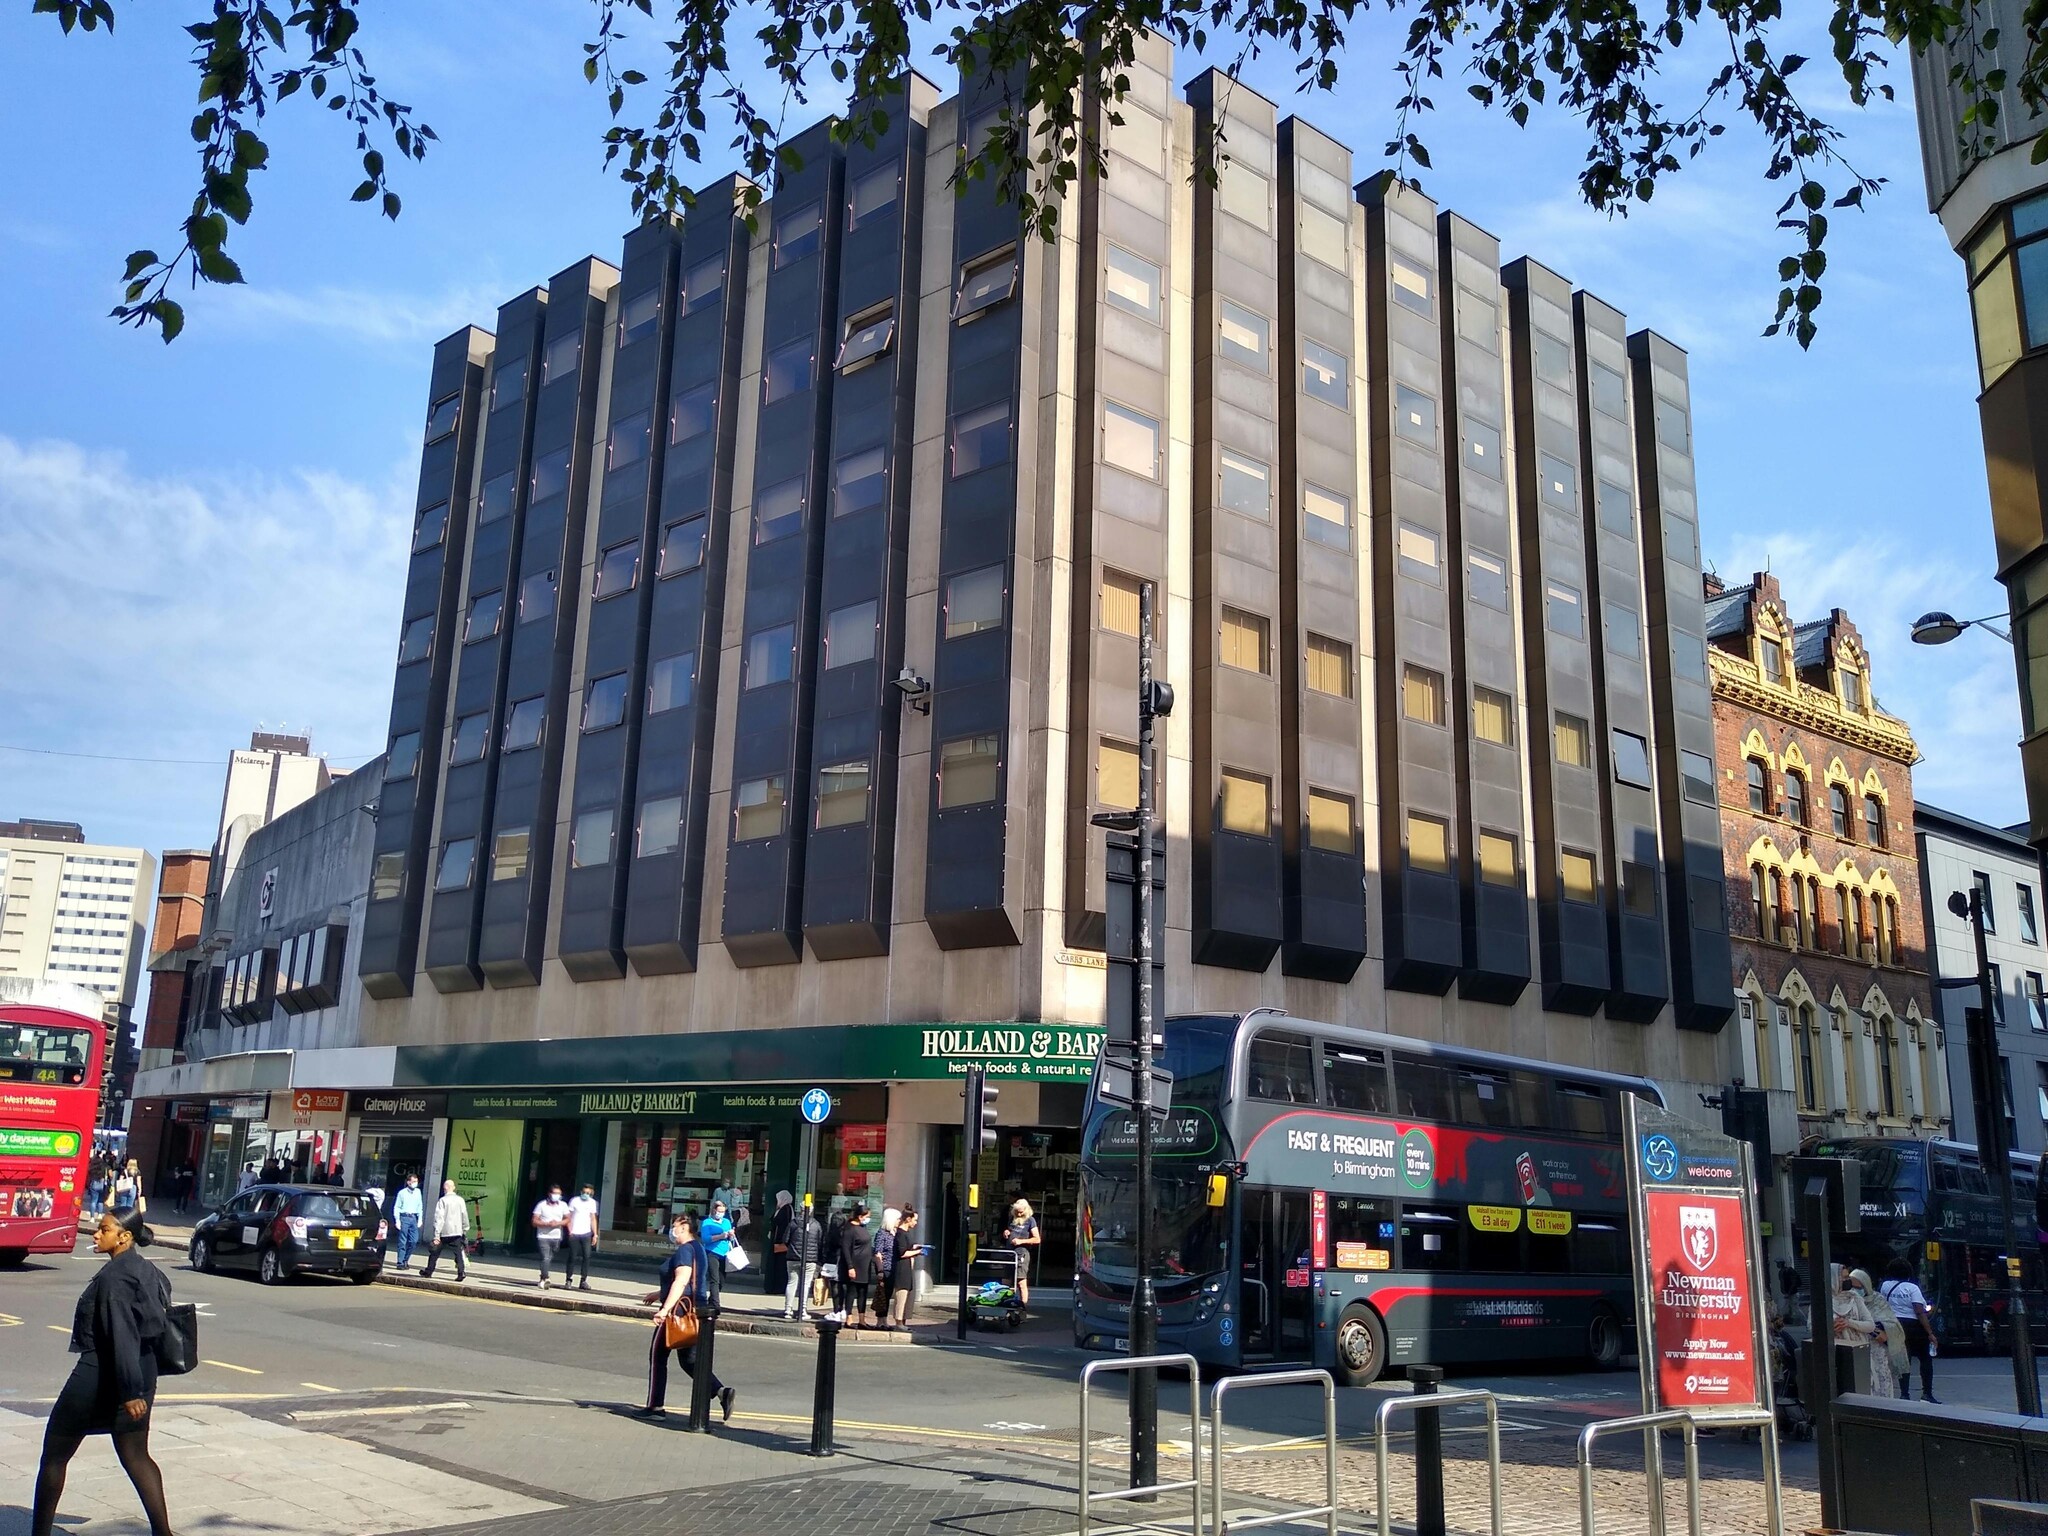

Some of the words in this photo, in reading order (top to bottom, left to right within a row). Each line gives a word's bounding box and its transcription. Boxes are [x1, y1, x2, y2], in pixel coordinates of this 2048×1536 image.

[1061, 954, 1083, 964] CARRS
[1086, 958, 1105, 967] LANE
[922, 1030, 1025, 1057] HOLLAND
[1029, 1031, 1052, 1058] &
[1057, 1032, 1107, 1055] BAR
[986, 1062, 1017, 1073] foods
[1021, 1063, 1031, 1074] &
[1036, 1063, 1076, 1075] natural
[36, 1069, 57, 1081] 4A
[4, 1095, 24, 1105] West
[24, 1096, 57, 1106] Midlands
[316, 1095, 340, 1103] LOVE
[473, 1098, 489, 1107] health
[490, 1098, 506, 1107] foods
[506, 1098, 511, 1106] &
[512, 1098, 531, 1107] natural
[532, 1098, 558, 1107] remedies
[580, 1094, 630, 1114] HOLLAND
[630, 1094, 643, 1114] &
[643, 1091, 697, 1114] BARRETT
[723, 1096, 745, 1106] health
[746, 1096, 767, 1106] foods
[769, 1097, 776, 1106] &
[364, 1098, 398, 1115] Gateway
[400, 1098, 427, 1112] House
[9, 1134, 51, 1145] daysaver
[1288, 1130, 1318, 1151] FAST
[1320, 1133, 1331, 1153] &
[1333, 1134, 1395, 1158] FREQUENT
[1406, 1149, 1425, 1161] every
[460, 1158, 478, 1168] CLICK
[480, 1159, 485, 1168] &
[1406, 1158, 1415, 1169] 10
[1415, 1161, 1430, 1171] mins
[1559, 1161, 1569, 1170] play
[1333, 1160, 1343, 1174] to
[1344, 1160, 1396, 1180] Birmingham
[1549, 1171, 1556, 1179] on
[1556, 1171, 1564, 1179] the
[1687, 1166, 1732, 1178] welcome
[458, 1171, 487, 1182] COLLECT
[1894, 1202, 1907, 1217] X1
[1482, 1215, 1491, 1226] £3
[1492, 1218, 1500, 1227] all
[1499, 1219, 1510, 1229] day
[1535, 1218, 1546, 1229] £11
[1551, 1222, 1566, 1230] week
[1942, 1210, 1955, 1228] X2
[1354, 1274, 1369, 1284] 6728
[1667, 1271, 1736, 1291] Newman
[1662, 1289, 1742, 1314] University
[1676, 1312, 1729, 1320] BIRMINGHAM
[1683, 1338, 1708, 1351] Apply
[1709, 1339, 1729, 1349] Now
[1665, 1350, 1745, 1361] www.newman.ac.uk
[1698, 1376, 1712, 1386] Stay
[1713, 1376, 1729, 1385] Local
